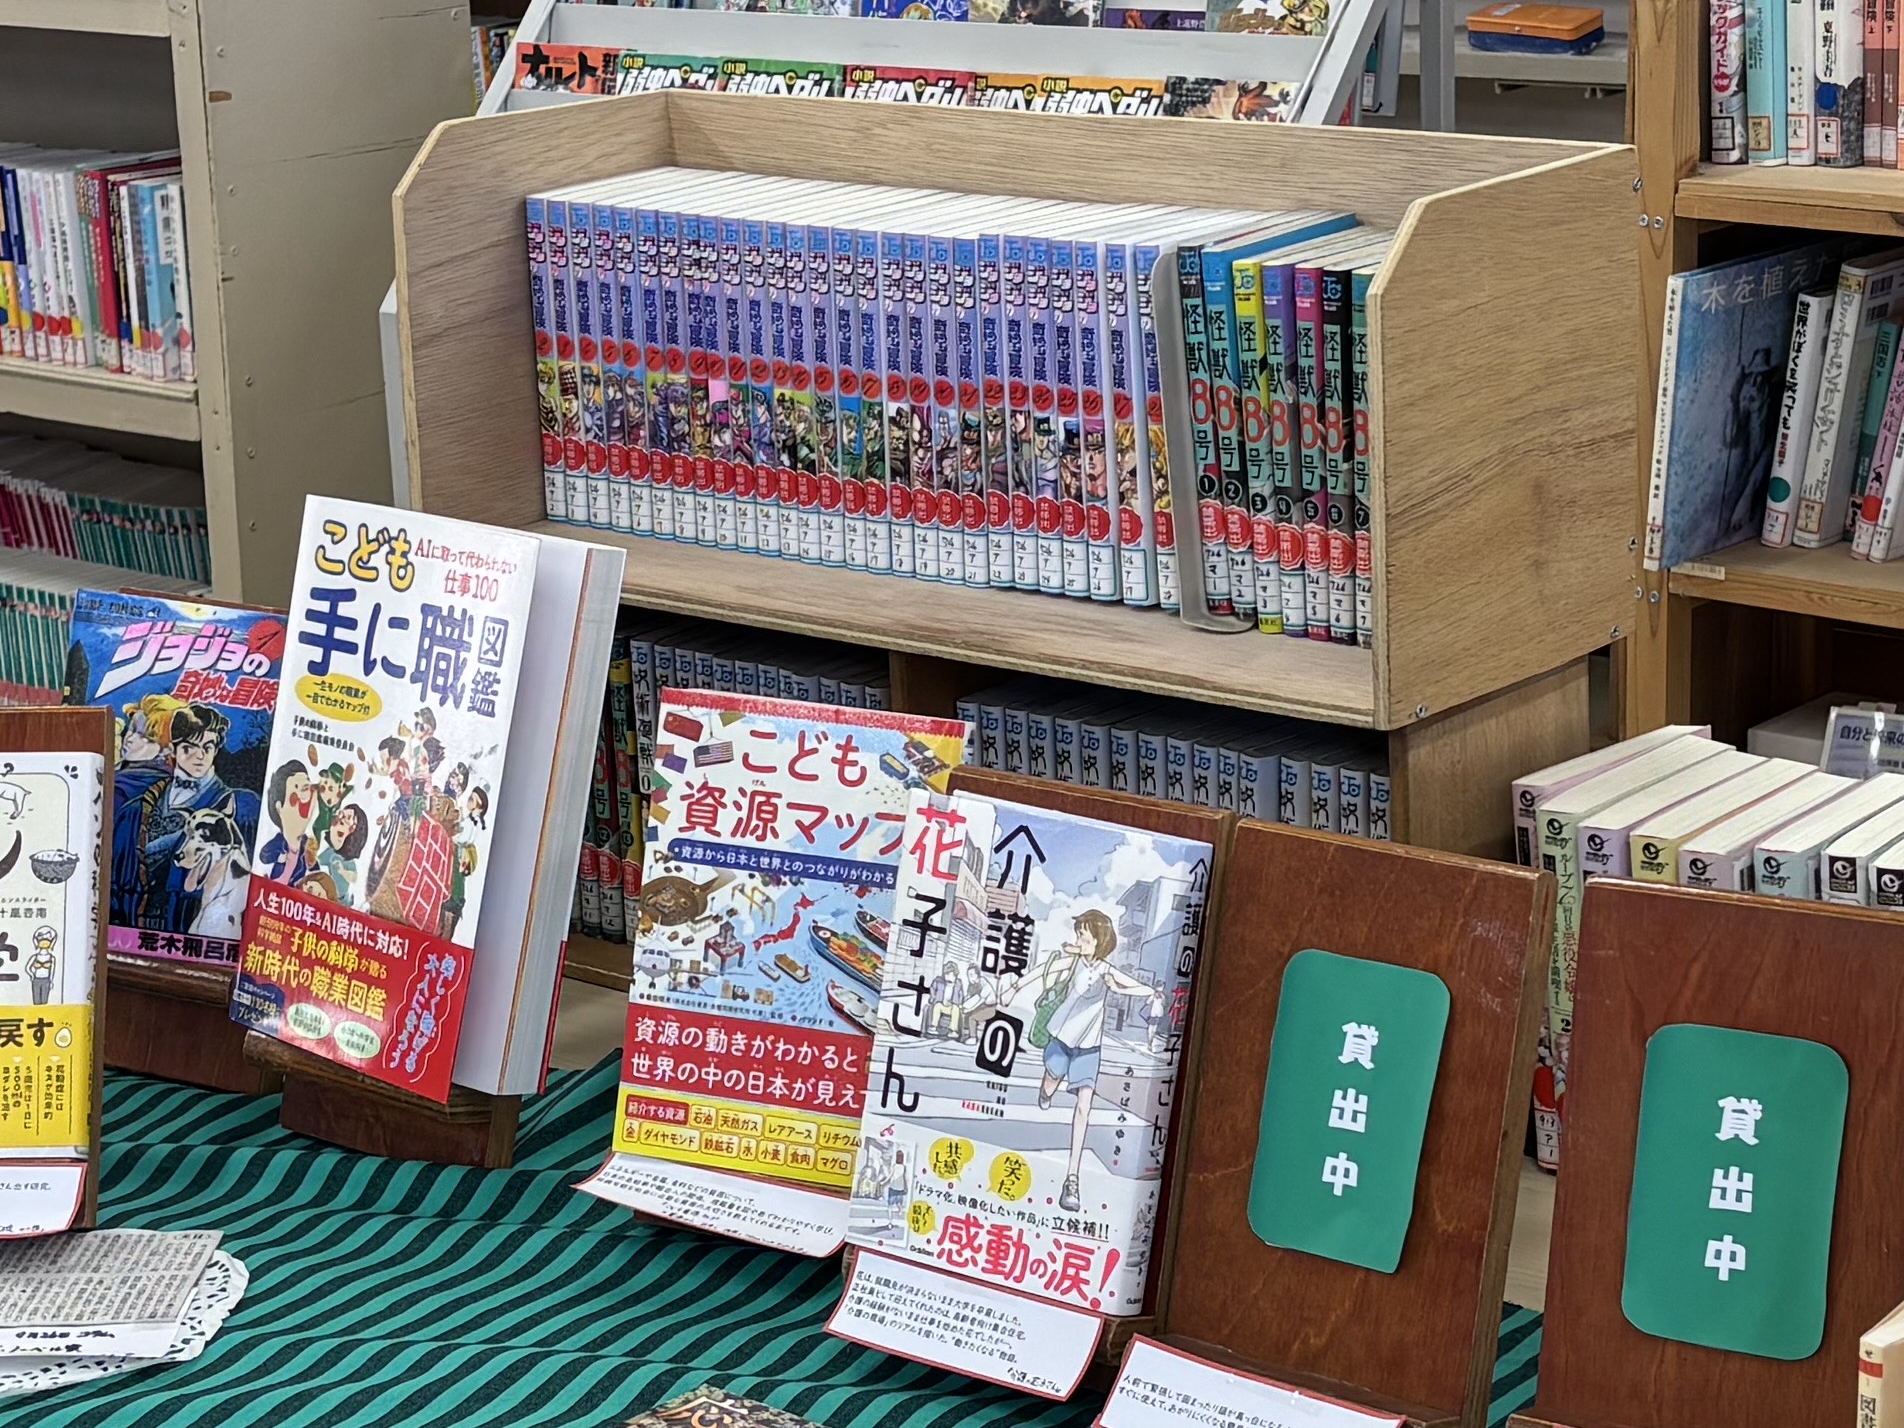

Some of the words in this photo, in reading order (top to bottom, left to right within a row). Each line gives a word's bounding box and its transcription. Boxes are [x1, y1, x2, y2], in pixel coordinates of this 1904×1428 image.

[520, 43, 600, 92] ナルト
[1042, 76, 1069, 93] 小説
[1209, 309, 1239, 471] 怪獣8号
[1239, 322, 1269, 479] 怪獣8号
[314, 517, 417, 592] こども
[413, 541, 519, 576] AIに取って代わらない
[443, 569, 501, 603] 仕事100
[94, 617, 271, 700] ジョジョの
[296, 585, 474, 711] 手に職
[466, 615, 510, 719] 図鑑
[170, 670, 279, 715] 奇妙な冒険
[740, 728, 870, 789] こども
[252, 885, 412, 961] 人生100年&AI時代に対応!
[290, 925, 360, 975] 子供の科学
[879, 804, 968, 1116] 花子さん
[976, 823, 1049, 1080] 介護の
[244, 941, 389, 1022] 新時代の職業図鑑
[630, 1051, 864, 1111] 世界の中の日本が見え
[634, 1015, 860, 1074] 資源の動きがわかると
[642, 1127, 698, 1149] ダイヤモンド
[767, 1122, 814, 1143] レアアース
[1321, 1020, 1381, 1198] 貸出中
[1703, 1095, 1765, 1283] 貸出中
[936, 1212, 1122, 1311] 感動の涙!
[1051, 1213, 1111, 1241] 立候補!!
